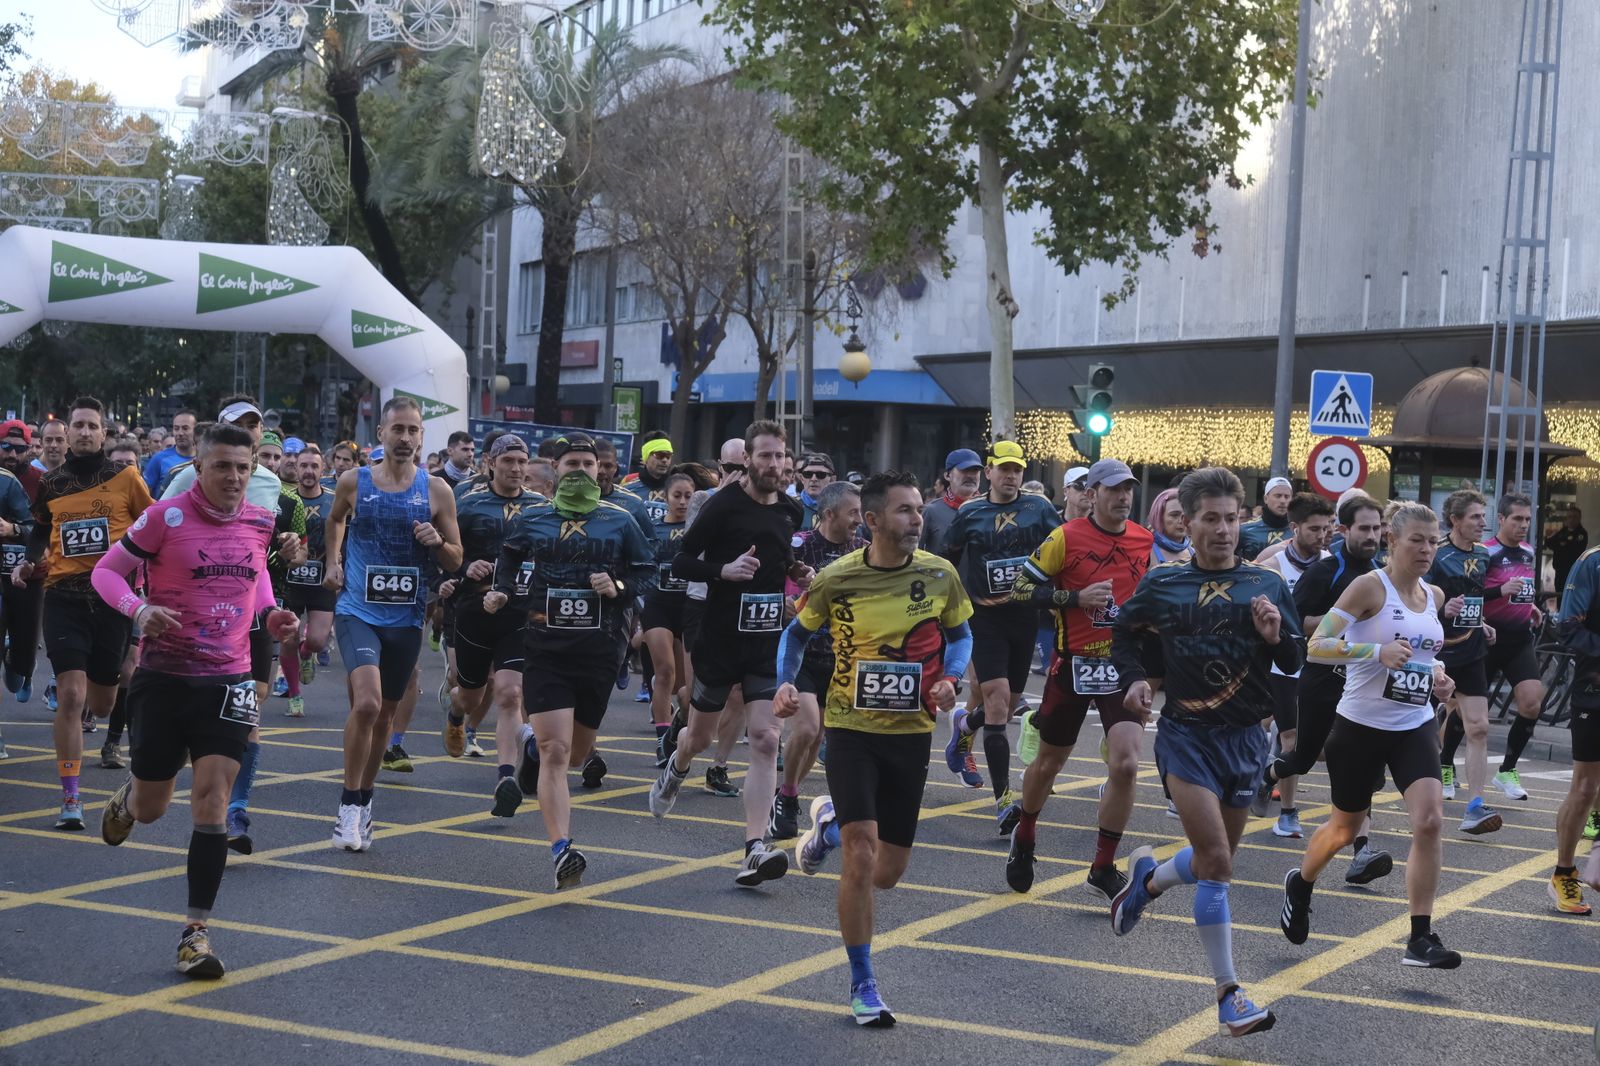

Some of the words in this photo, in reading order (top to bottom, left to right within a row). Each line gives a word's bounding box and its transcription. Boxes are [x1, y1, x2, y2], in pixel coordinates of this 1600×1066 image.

[53, 262, 67, 277] El
[70, 264, 100, 280] Corte
[101, 263, 147, 287] Inglés
[201, 273, 215, 288] El
[217, 274, 248, 290] Corte
[249, 272, 294, 295] Inglés
[353, 324, 361, 333] El
[363, 324, 382, 334] Corte
[383, 321, 411, 336] Inglés
[813, 380, 839, 396] badell
[421, 401, 448, 416] Inglés
[1321, 456, 1354, 478] 20
[647, 506, 669, 520] 19
[66, 526, 104, 545] 270
[560, 519, 588, 541] IX
[3, 552, 26, 565] 92
[372, 575, 413, 592] 646
[910, 580, 926, 602] 8
[1517, 584, 1534, 596] 52
[1197, 581, 1235, 608] IX
[560, 598, 589, 616] 89
[748, 602, 779, 619] 175
[906, 599, 934, 613] SUBIDA
[1460, 604, 1480, 618] 568
[1394, 632, 1443, 652] idea
[1079, 665, 1120, 682] 249
[1392, 670, 1430, 692] 204
[863, 673, 915, 695] 520
[233, 687, 258, 711] 34
